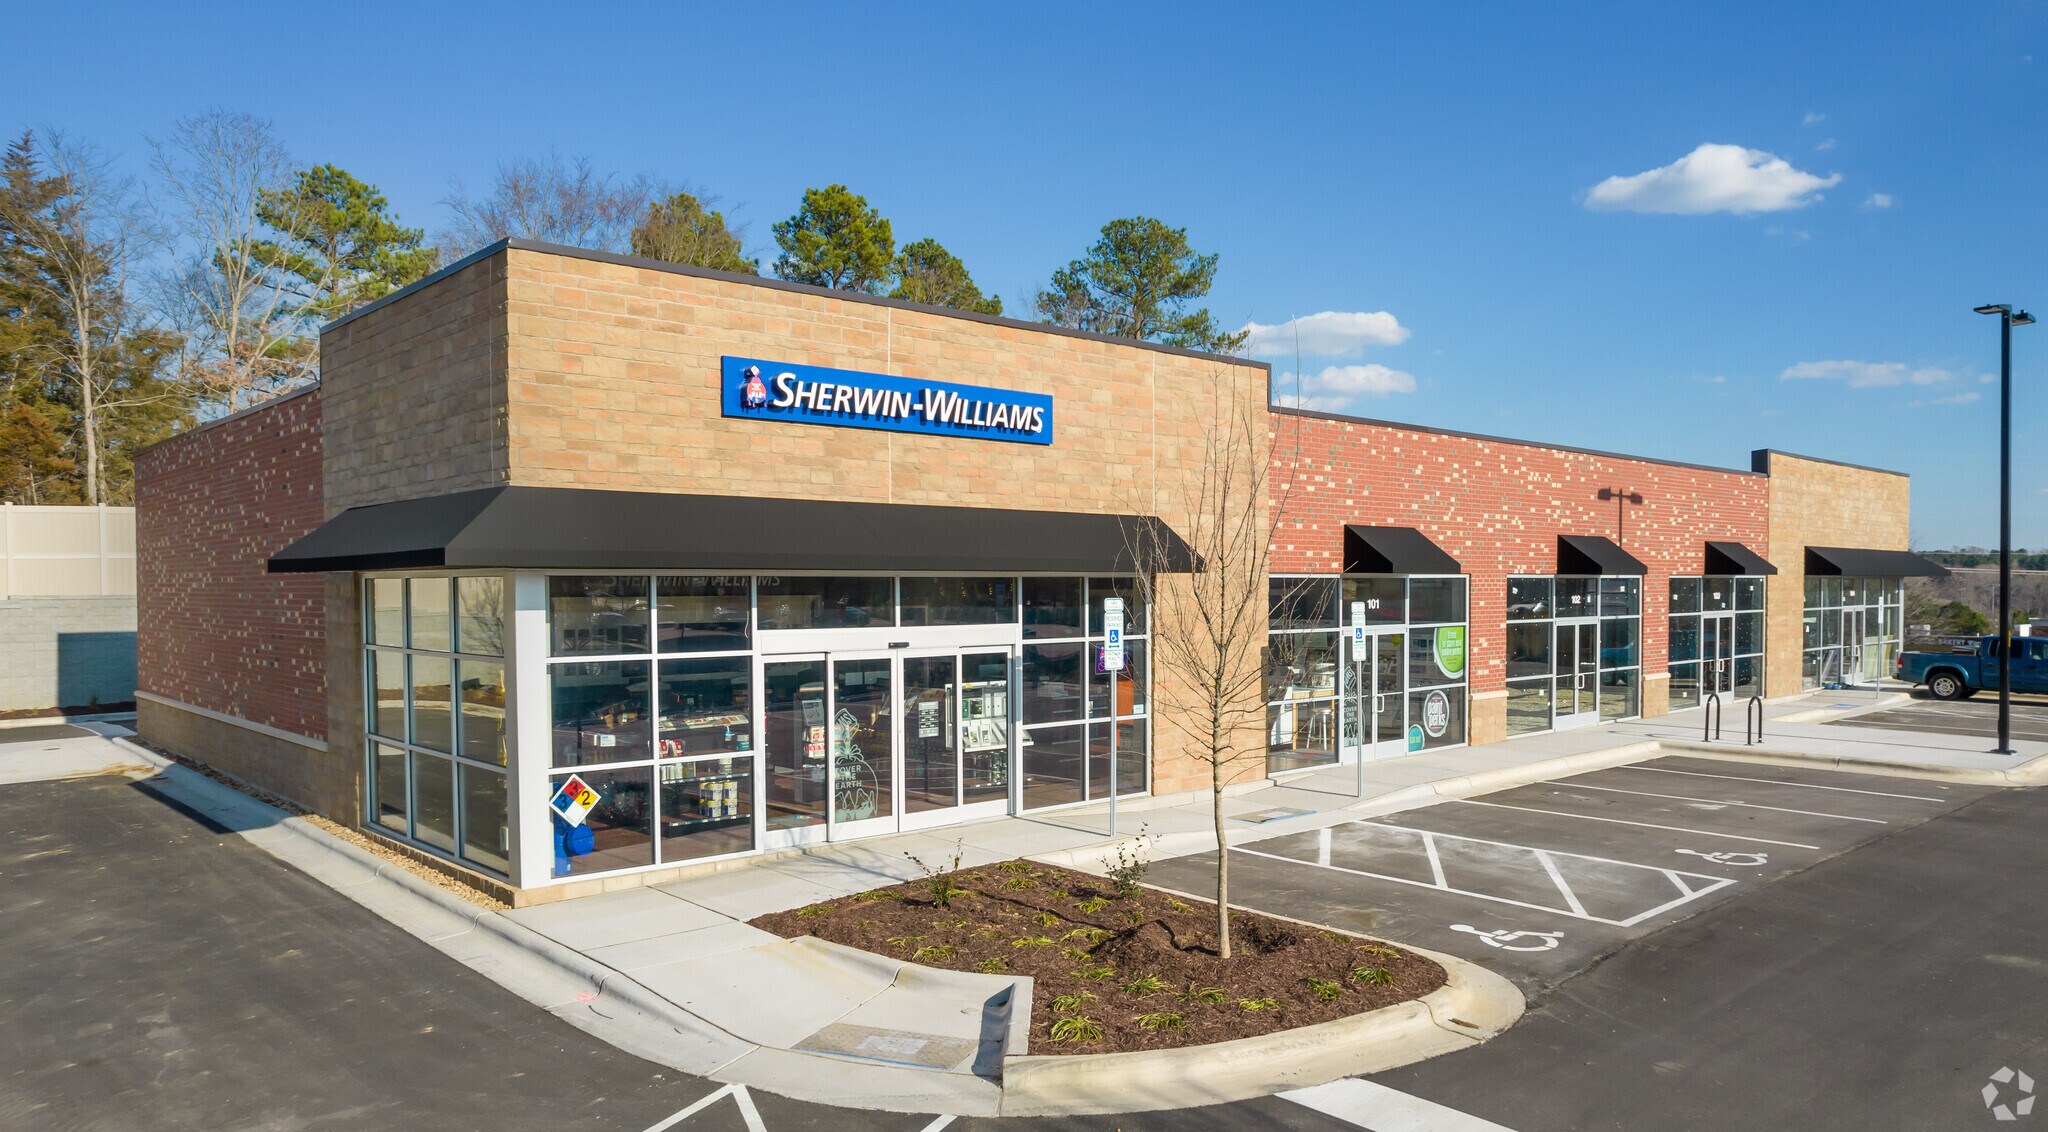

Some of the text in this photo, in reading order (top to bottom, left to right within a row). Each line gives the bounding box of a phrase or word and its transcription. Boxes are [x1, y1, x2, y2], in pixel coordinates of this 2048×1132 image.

[1367, 598, 1379, 609] 101
[1571, 595, 1581, 604] 102
[570, 781, 579, 796] 3
[835, 781, 862, 790] EARTH
[559, 794, 567, 809] 3
[582, 791, 590, 805] 2
